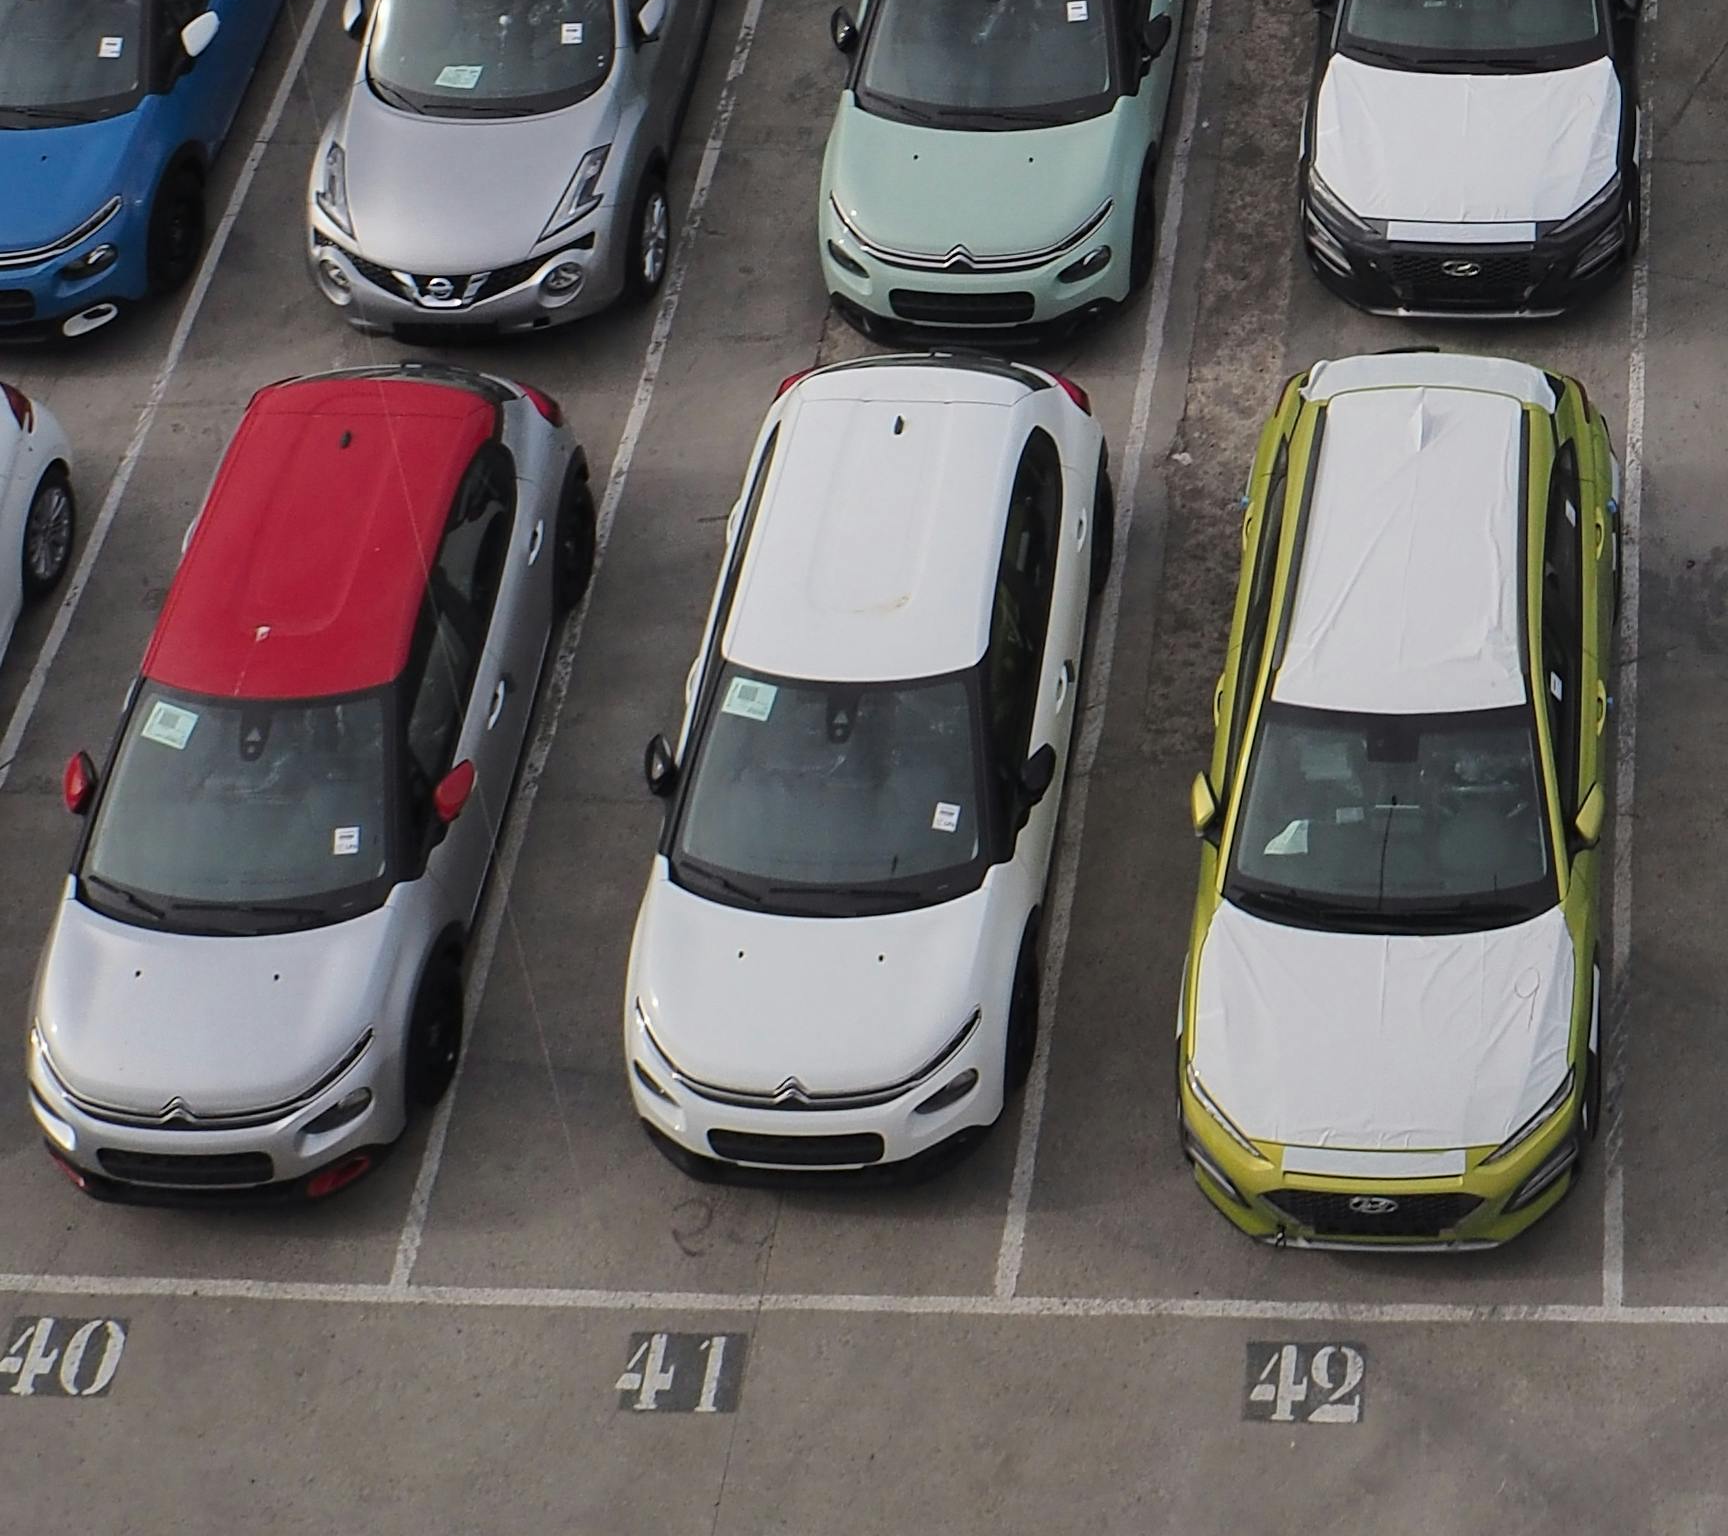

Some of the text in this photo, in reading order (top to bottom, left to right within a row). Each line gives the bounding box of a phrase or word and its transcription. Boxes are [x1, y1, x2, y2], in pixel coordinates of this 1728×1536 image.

[0, 1316, 126, 1397] 40
[615, 1333, 725, 1413] 41
[1249, 1344, 1364, 1423] 42
